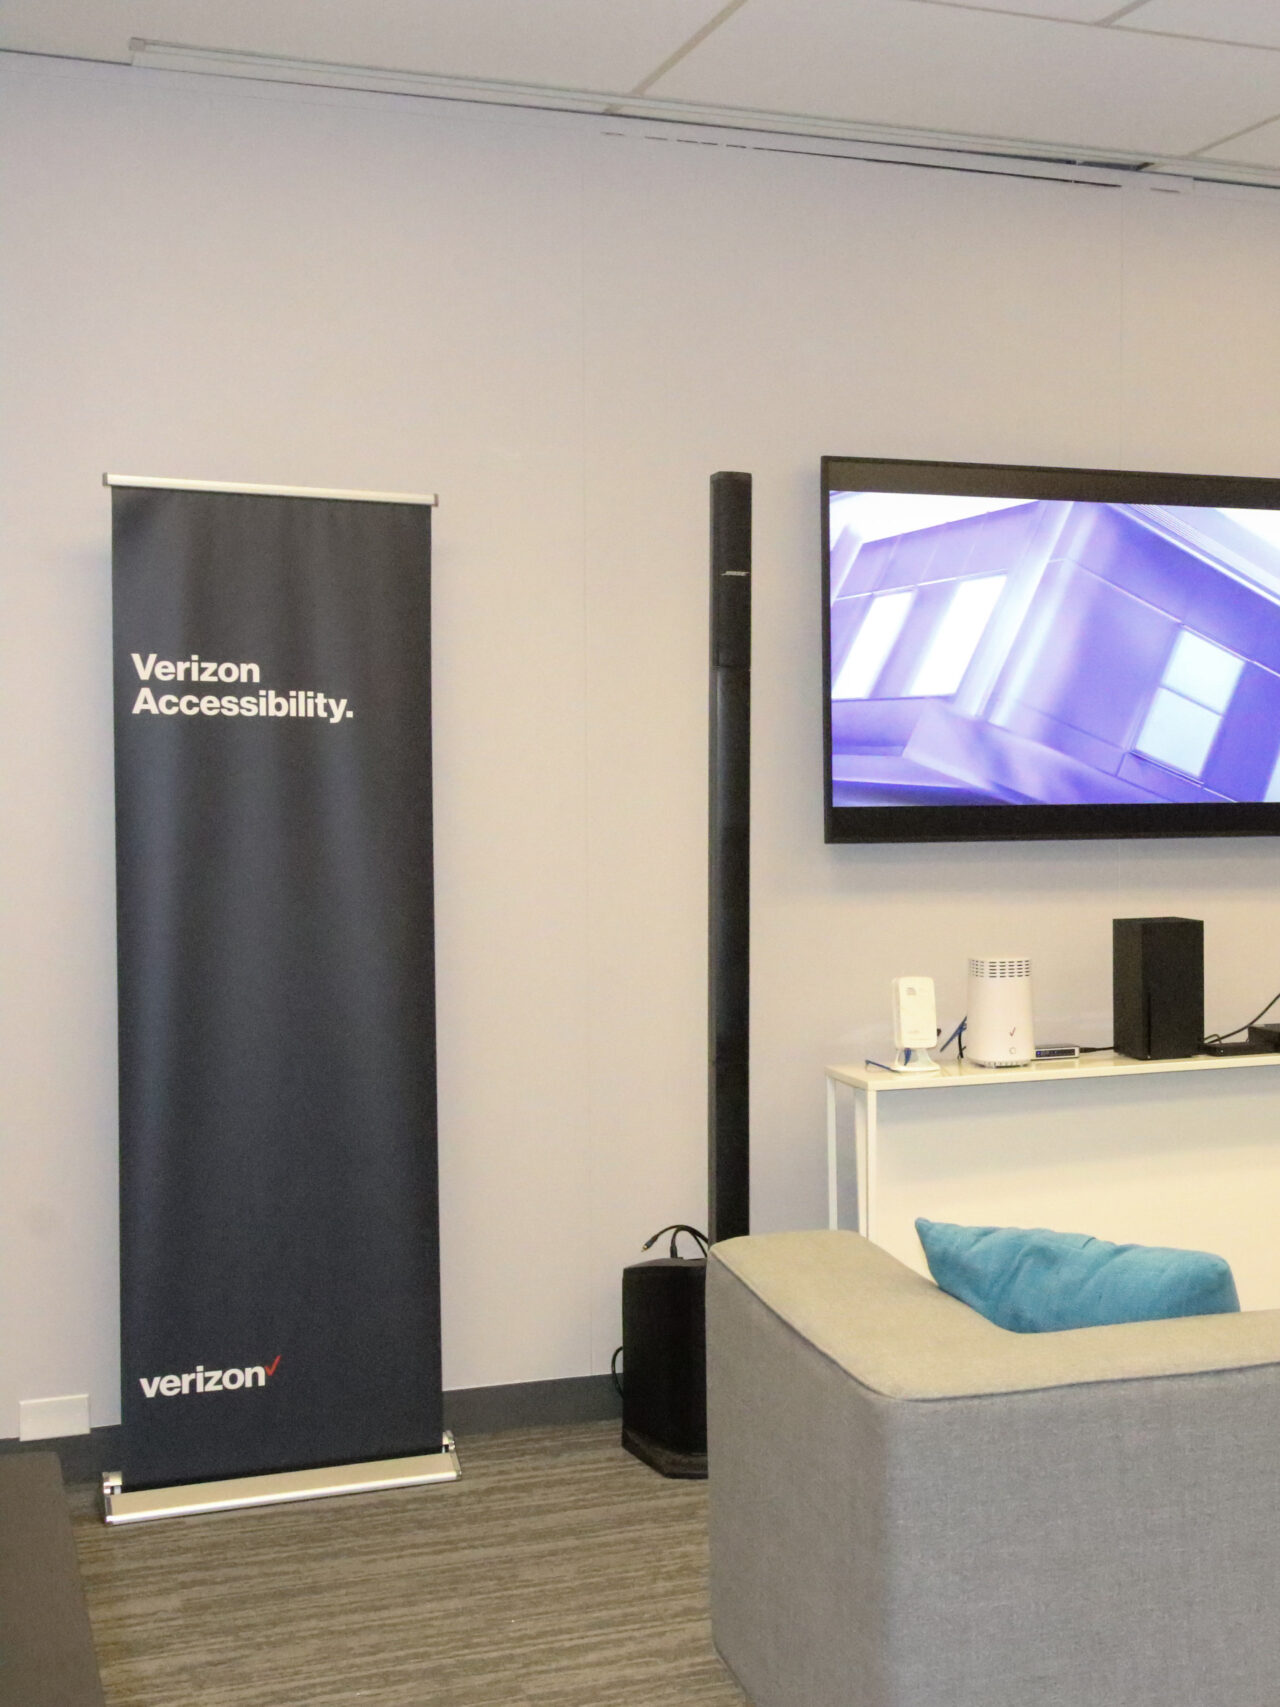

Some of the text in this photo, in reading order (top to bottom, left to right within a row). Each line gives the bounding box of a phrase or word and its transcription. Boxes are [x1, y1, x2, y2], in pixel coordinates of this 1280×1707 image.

[131, 653, 260, 683] Verizon
[132, 687, 354, 723] Accessibility.
[139, 1365, 266, 1398] verizon
